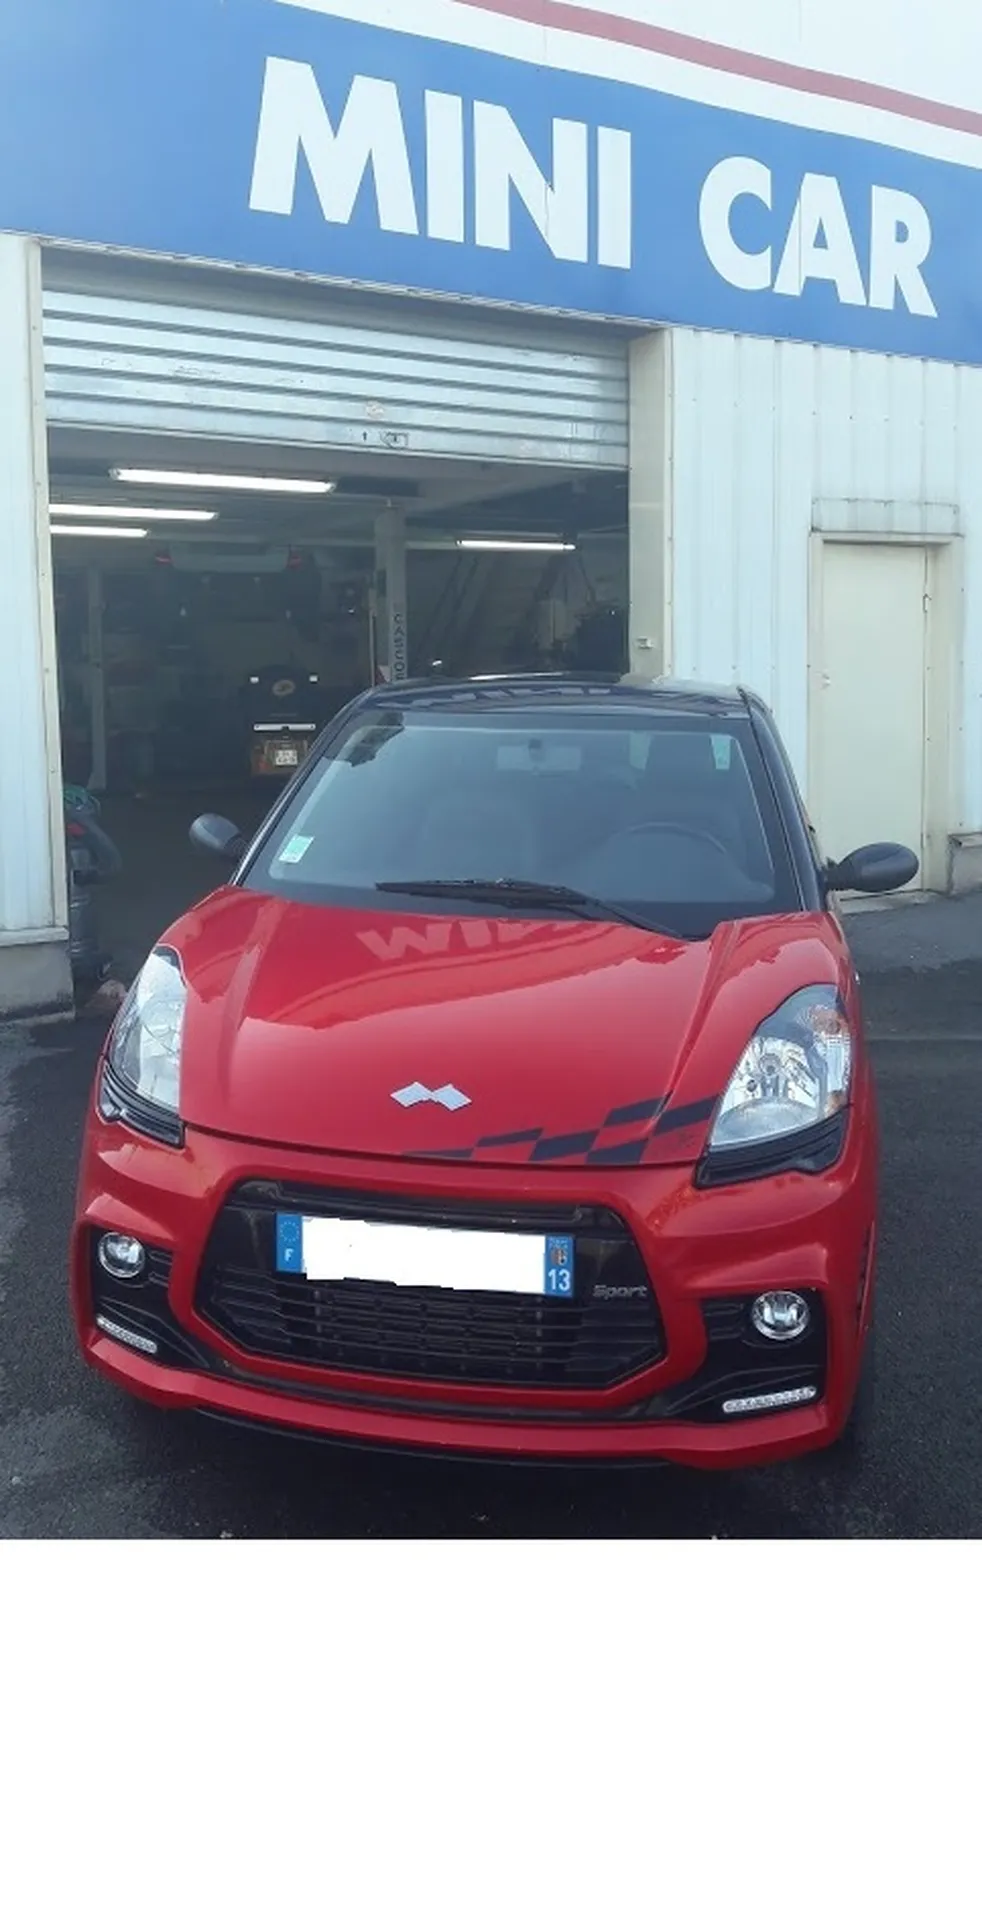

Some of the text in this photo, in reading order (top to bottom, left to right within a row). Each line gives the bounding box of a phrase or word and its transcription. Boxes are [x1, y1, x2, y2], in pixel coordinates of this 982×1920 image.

[249, 56, 938, 318] MINI CAR
[284, 1247, 295, 1262] F
[548, 1268, 570, 1292] 13
[593, 1284, 648, 1300] Sport
